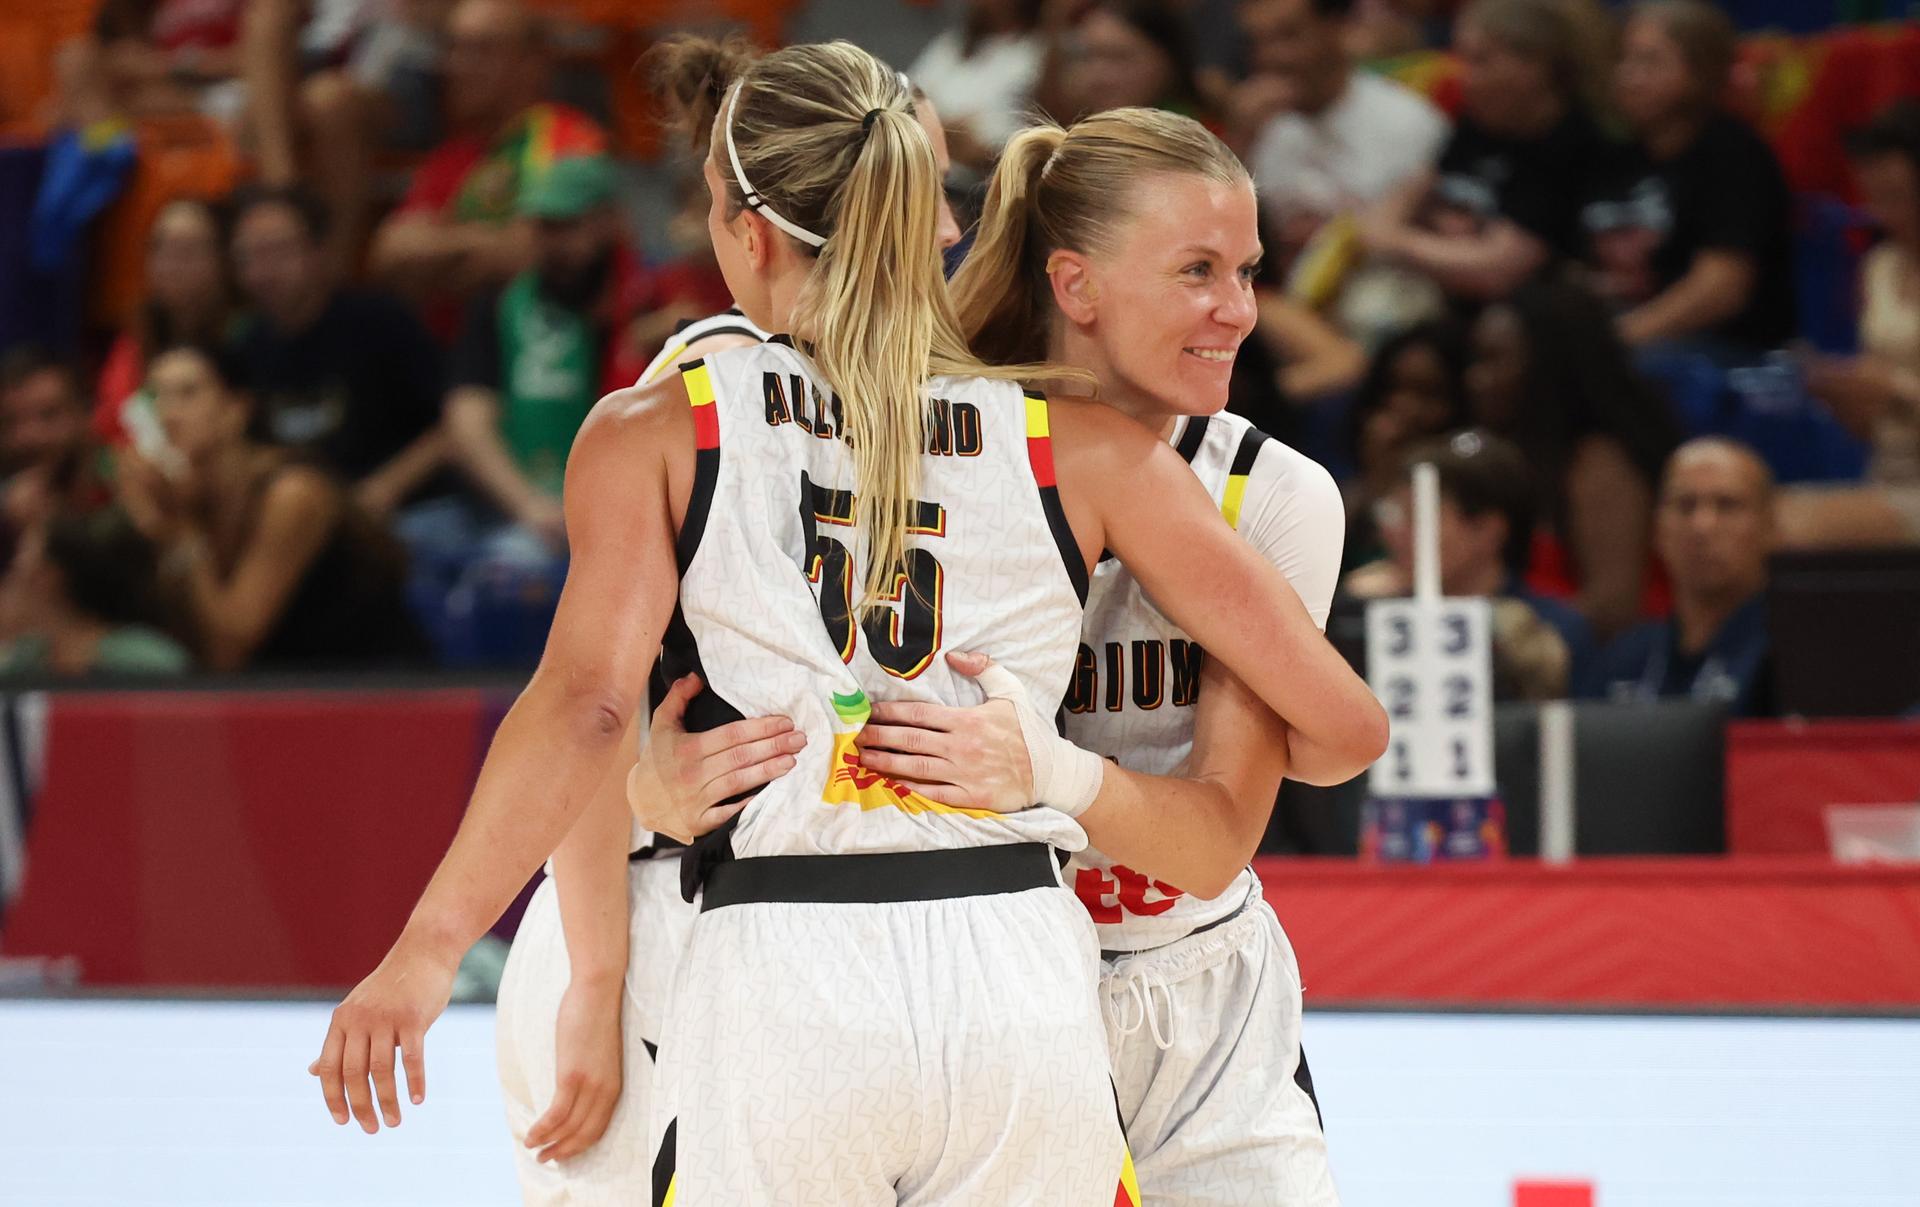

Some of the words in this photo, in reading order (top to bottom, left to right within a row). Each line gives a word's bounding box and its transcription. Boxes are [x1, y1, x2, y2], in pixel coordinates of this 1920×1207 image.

[763, 372, 982, 456] ALLND
[800, 470, 946, 681] 55
[1386, 613, 1414, 657] 3
[1441, 613, 1471, 657] 3
[1388, 675, 1415, 718] 2
[1444, 675, 1472, 718] 2
[1392, 738, 1413, 780] 1
[1450, 737, 1471, 779] 1
